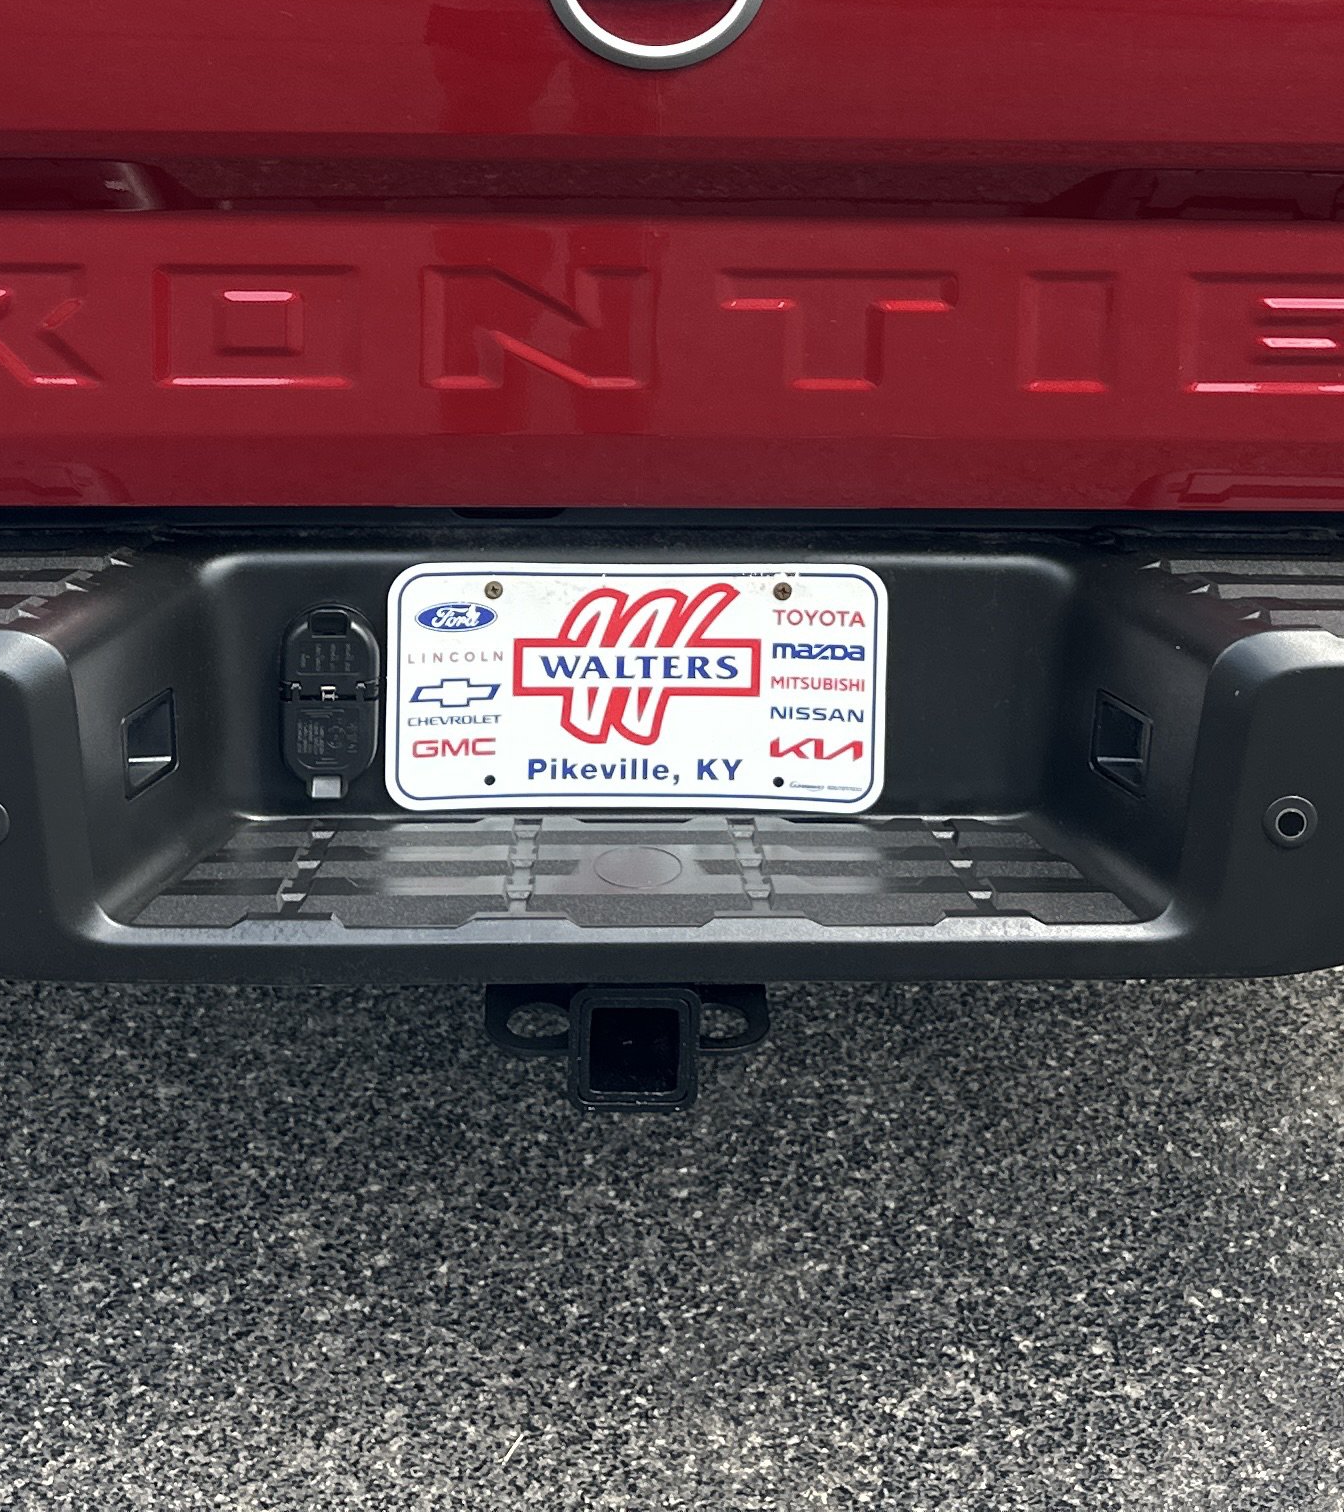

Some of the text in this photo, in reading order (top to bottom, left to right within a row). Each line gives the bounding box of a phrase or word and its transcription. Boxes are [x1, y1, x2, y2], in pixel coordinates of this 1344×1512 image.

[431, 604, 481, 628] Ford
[772, 609, 866, 628] TOYOTA
[407, 651, 504, 664] LINCOLN
[539, 655, 739, 680] WALTERS
[770, 676, 866, 692] MITSUBISHI
[407, 714, 502, 727] CHEVROLET
[770, 706, 864, 723] NISSAN
[412, 737, 496, 758] GMC
[769, 736, 864, 761] KIA
[527, 758, 744, 786] Pikeville, KY
